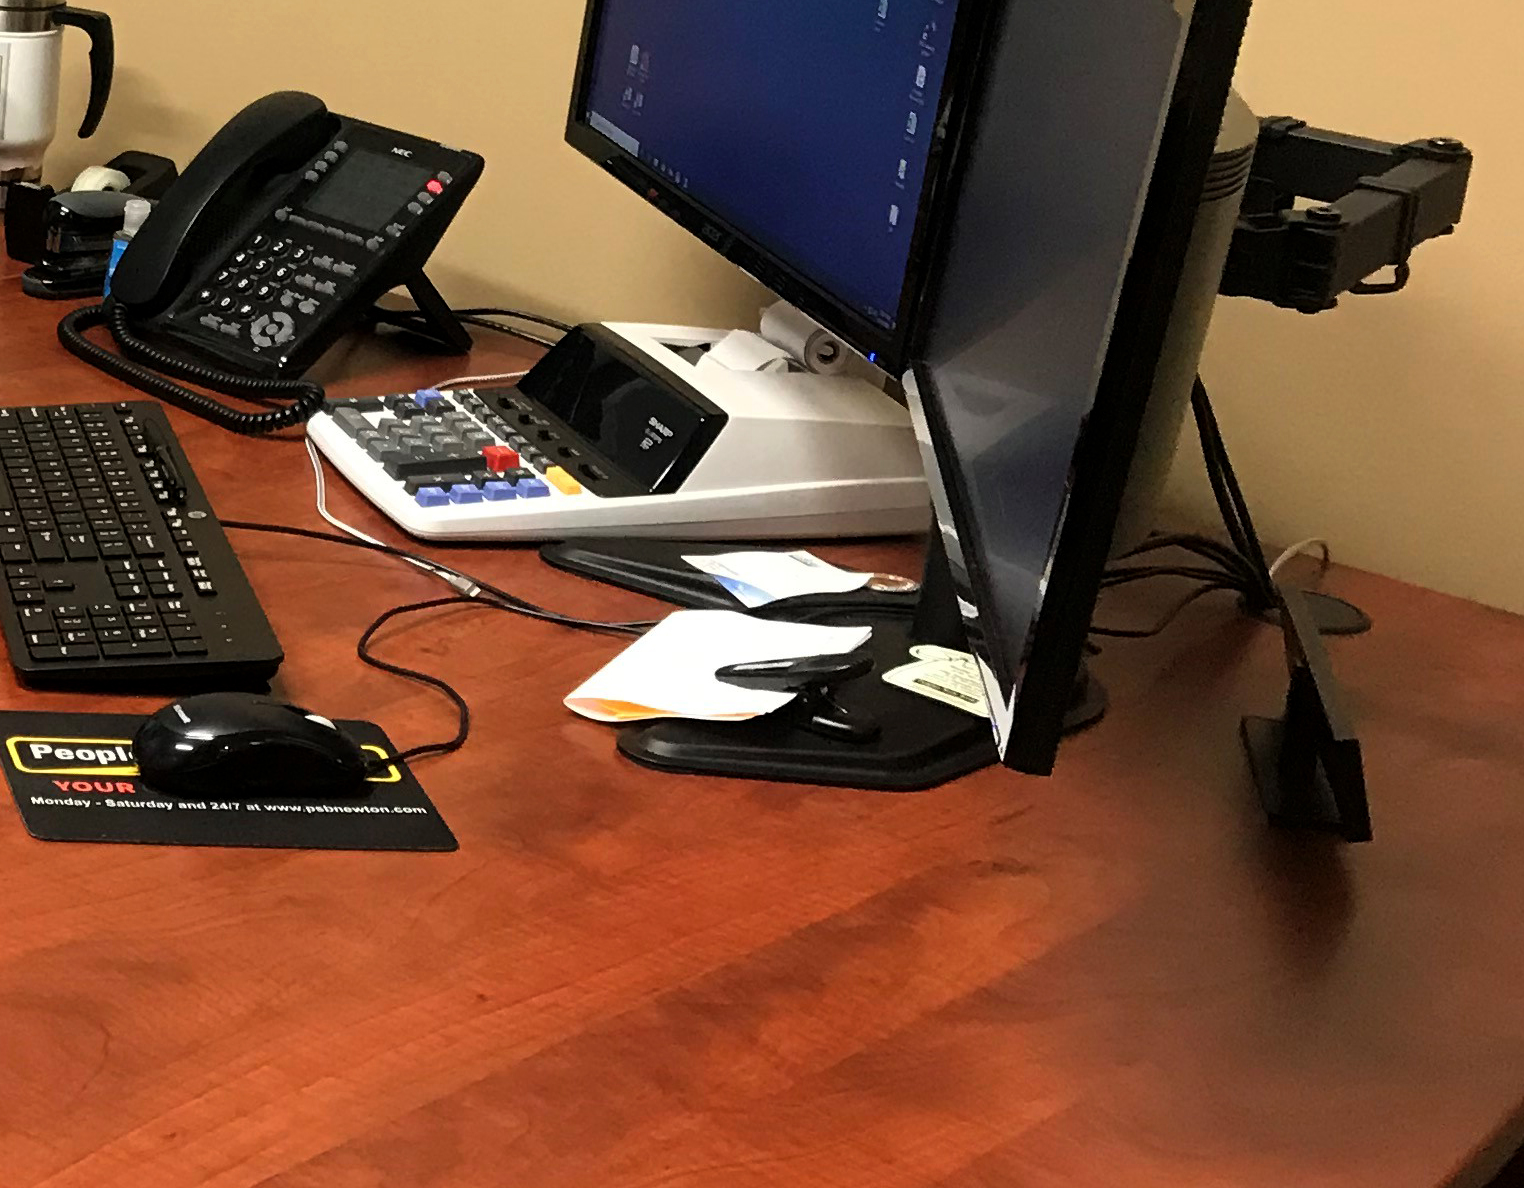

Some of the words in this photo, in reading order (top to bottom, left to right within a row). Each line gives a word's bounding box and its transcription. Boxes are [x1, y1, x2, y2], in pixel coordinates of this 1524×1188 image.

[29, 743, 134, 765] Peopl
[52, 779, 136, 794] YOUR
[30, 796, 91, 808] Monday
[105, 798, 173, 811] Saturday
[178, 801, 207, 810] and
[210, 801, 240, 811] 24/7
[246, 803, 262, 812] at
[264, 803, 428, 814] www.psbnewton.com
